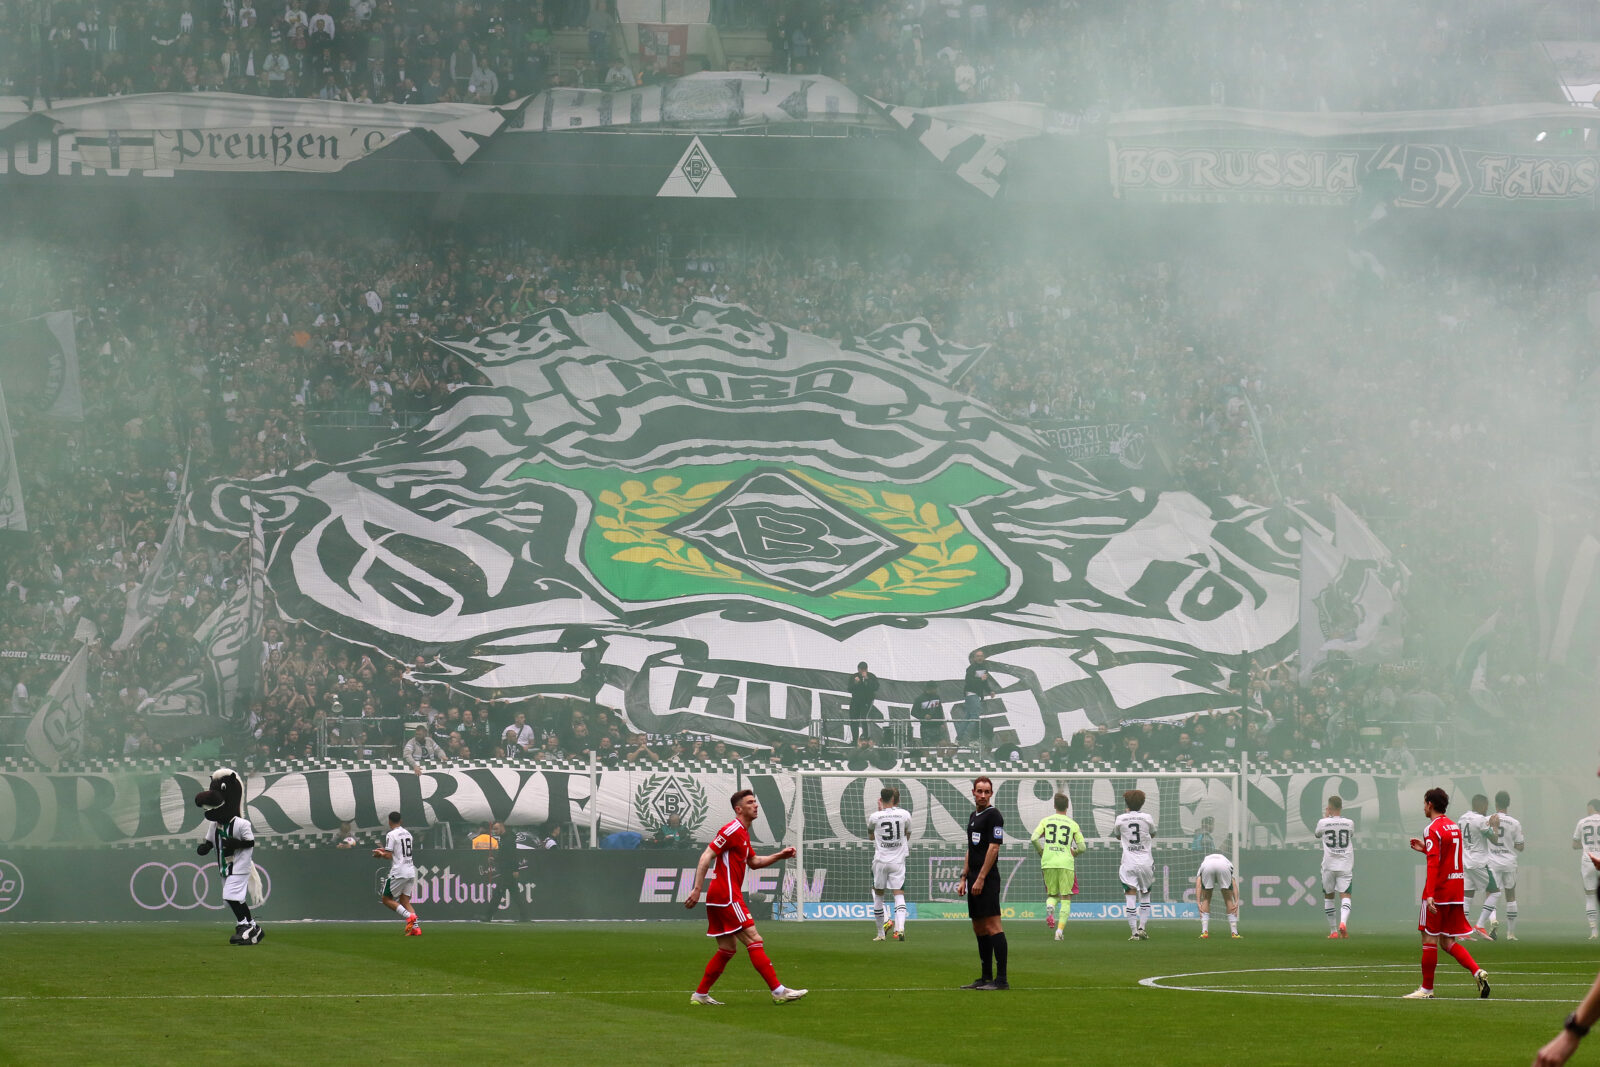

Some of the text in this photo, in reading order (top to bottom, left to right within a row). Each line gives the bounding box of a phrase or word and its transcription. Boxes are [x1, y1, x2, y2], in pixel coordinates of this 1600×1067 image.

[1119, 149, 1359, 193] BORUSSIA
[1480, 158, 1598, 199] FANS
[880, 821, 900, 841] 31
[1046, 823, 1071, 846] 33
[1128, 823, 1140, 844] 3
[1325, 829, 1349, 849] 30
[400, 837, 412, 858] 18
[1452, 838, 1460, 870] 7
